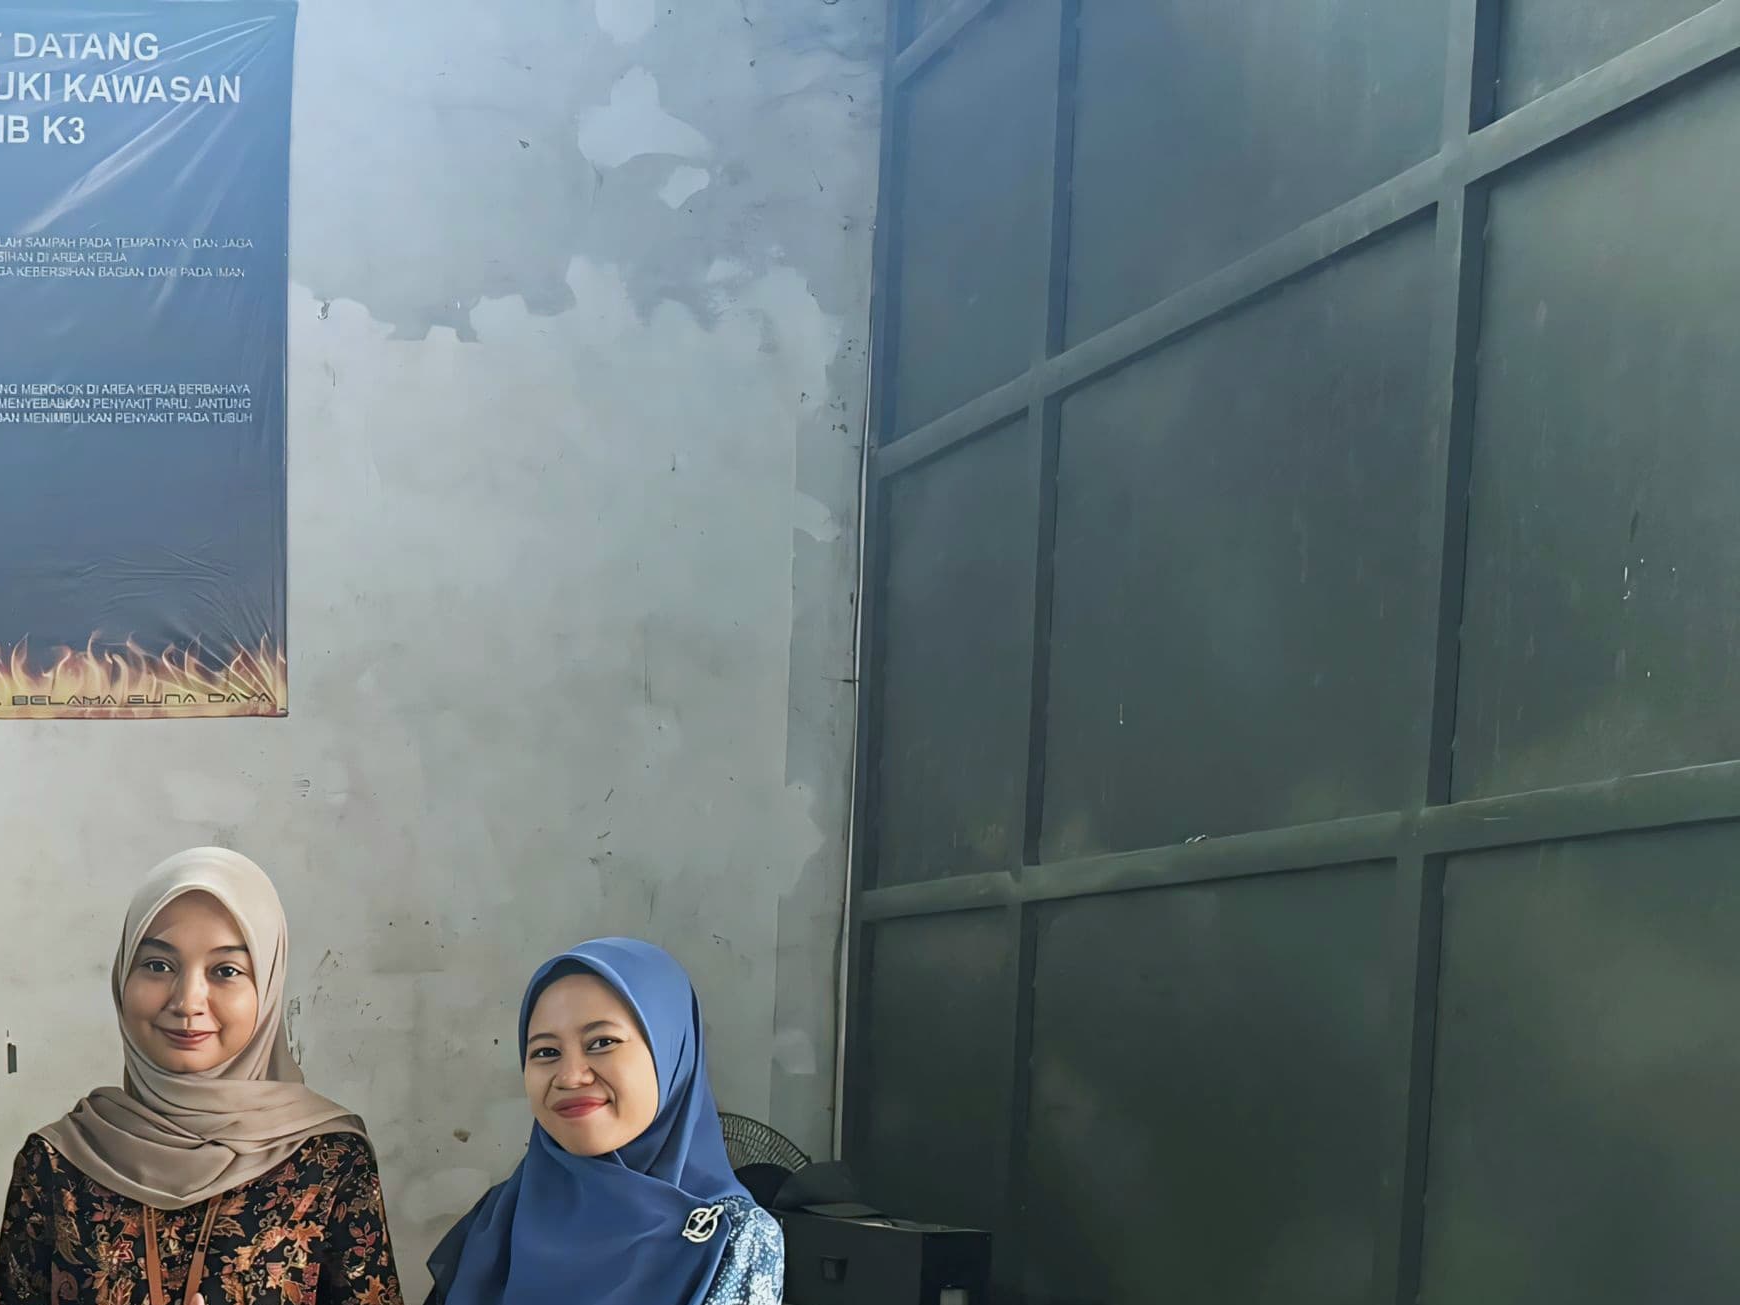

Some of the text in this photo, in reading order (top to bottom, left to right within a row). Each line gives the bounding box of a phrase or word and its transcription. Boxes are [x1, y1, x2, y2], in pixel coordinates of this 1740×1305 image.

[14, 31, 159, 62] DATANG
[63, 72, 240, 104] KAWASAN
[43, 115, 85, 145] K3
[24, 236, 76, 248] SAMPAH
[79, 237, 112, 248] PADA
[193, 238, 218, 249] DAN
[221, 238, 253, 249] JAGA
[36, 251, 50, 262] DI
[51, 251, 85, 262] AREA
[87, 251, 128, 262] KERJA
[16, 265, 95, 277] KEBERSIHAN
[98, 265, 144, 277] BAGIAN
[147, 266, 177, 278] DARI
[179, 266, 213, 278] PADA
[20, 384, 84, 395] MEROKOK
[86, 384, 100, 395] DI
[101, 384, 135, 396] AREA
[136, 385, 176, 396] KERJA
[178, 385, 251, 396] BERBAHAYA
[93, 398, 153, 409] PENYAKIT
[194, 398, 252, 410] JANTUNG
[22, 412, 113, 424] MENIMBULKAN
[115, 413, 175, 424] PENYAKIT
[177, 413, 210, 424] PADA
[211, 413, 253, 424] TUBUH
[11, 695, 117, 705] BELAMA
